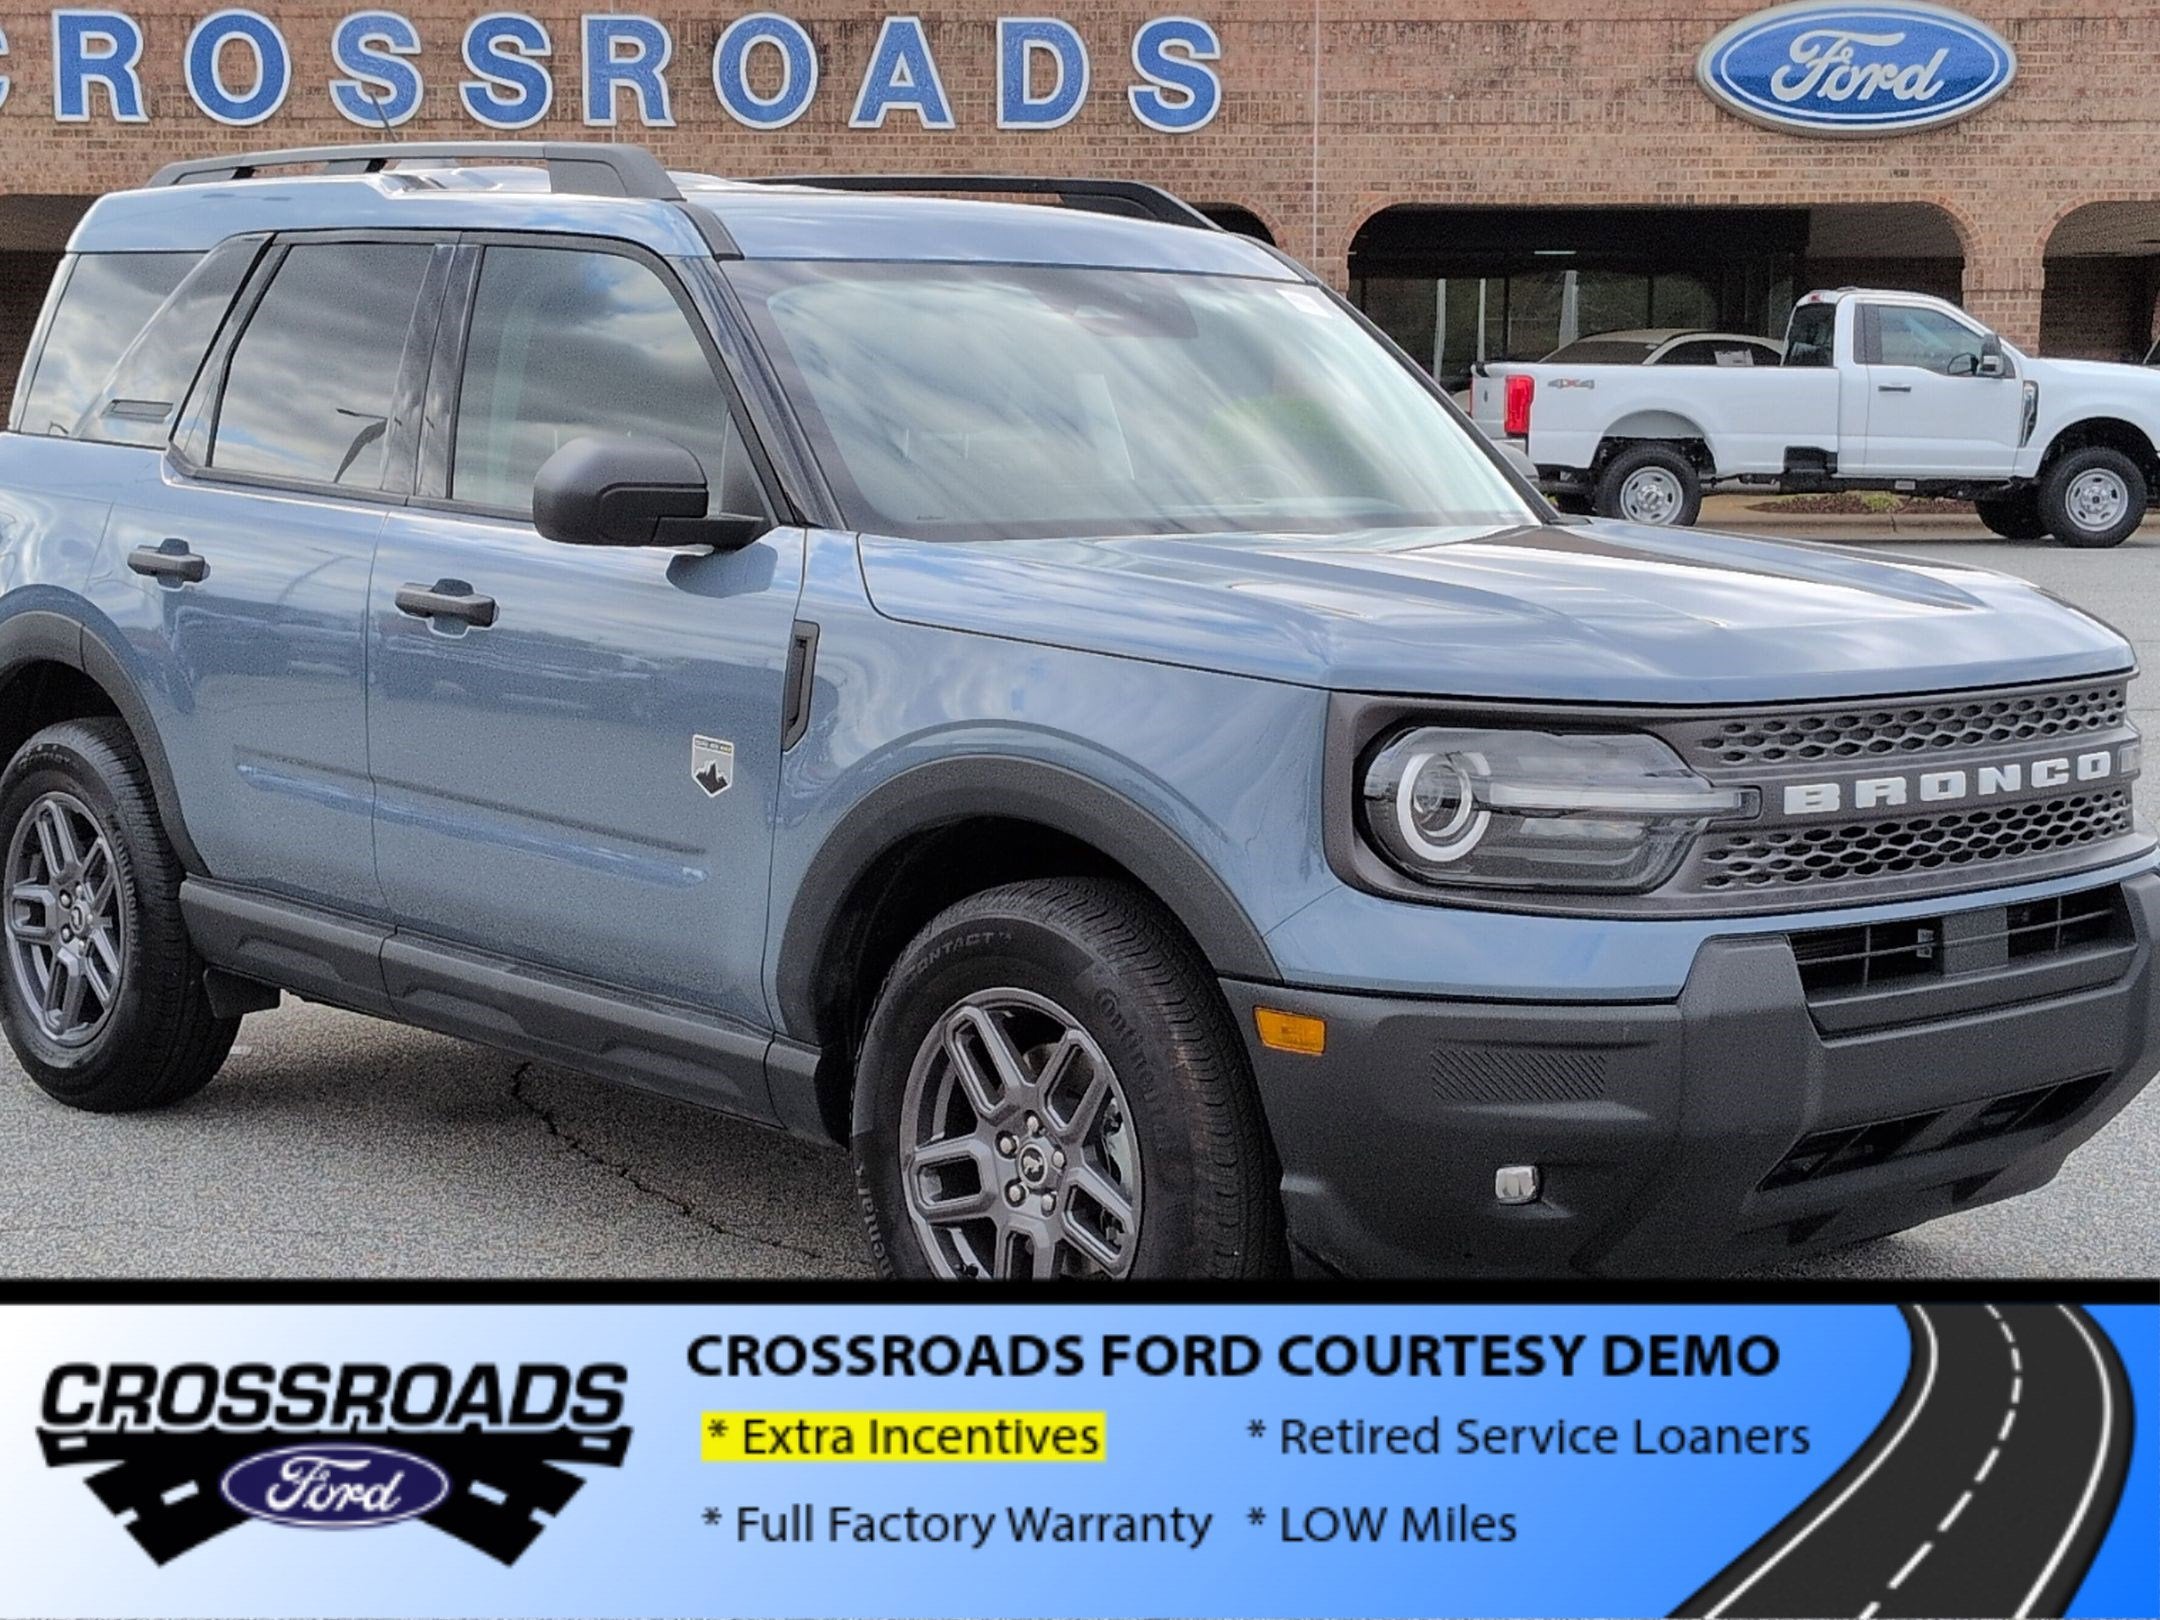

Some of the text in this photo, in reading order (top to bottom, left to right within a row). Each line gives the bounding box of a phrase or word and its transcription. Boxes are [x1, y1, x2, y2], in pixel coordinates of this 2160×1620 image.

[0, 9, 1221, 133] ROSSROADS
[1771, 29, 1949, 102] Ford
[1783, 751, 2112, 815] BRONCO
